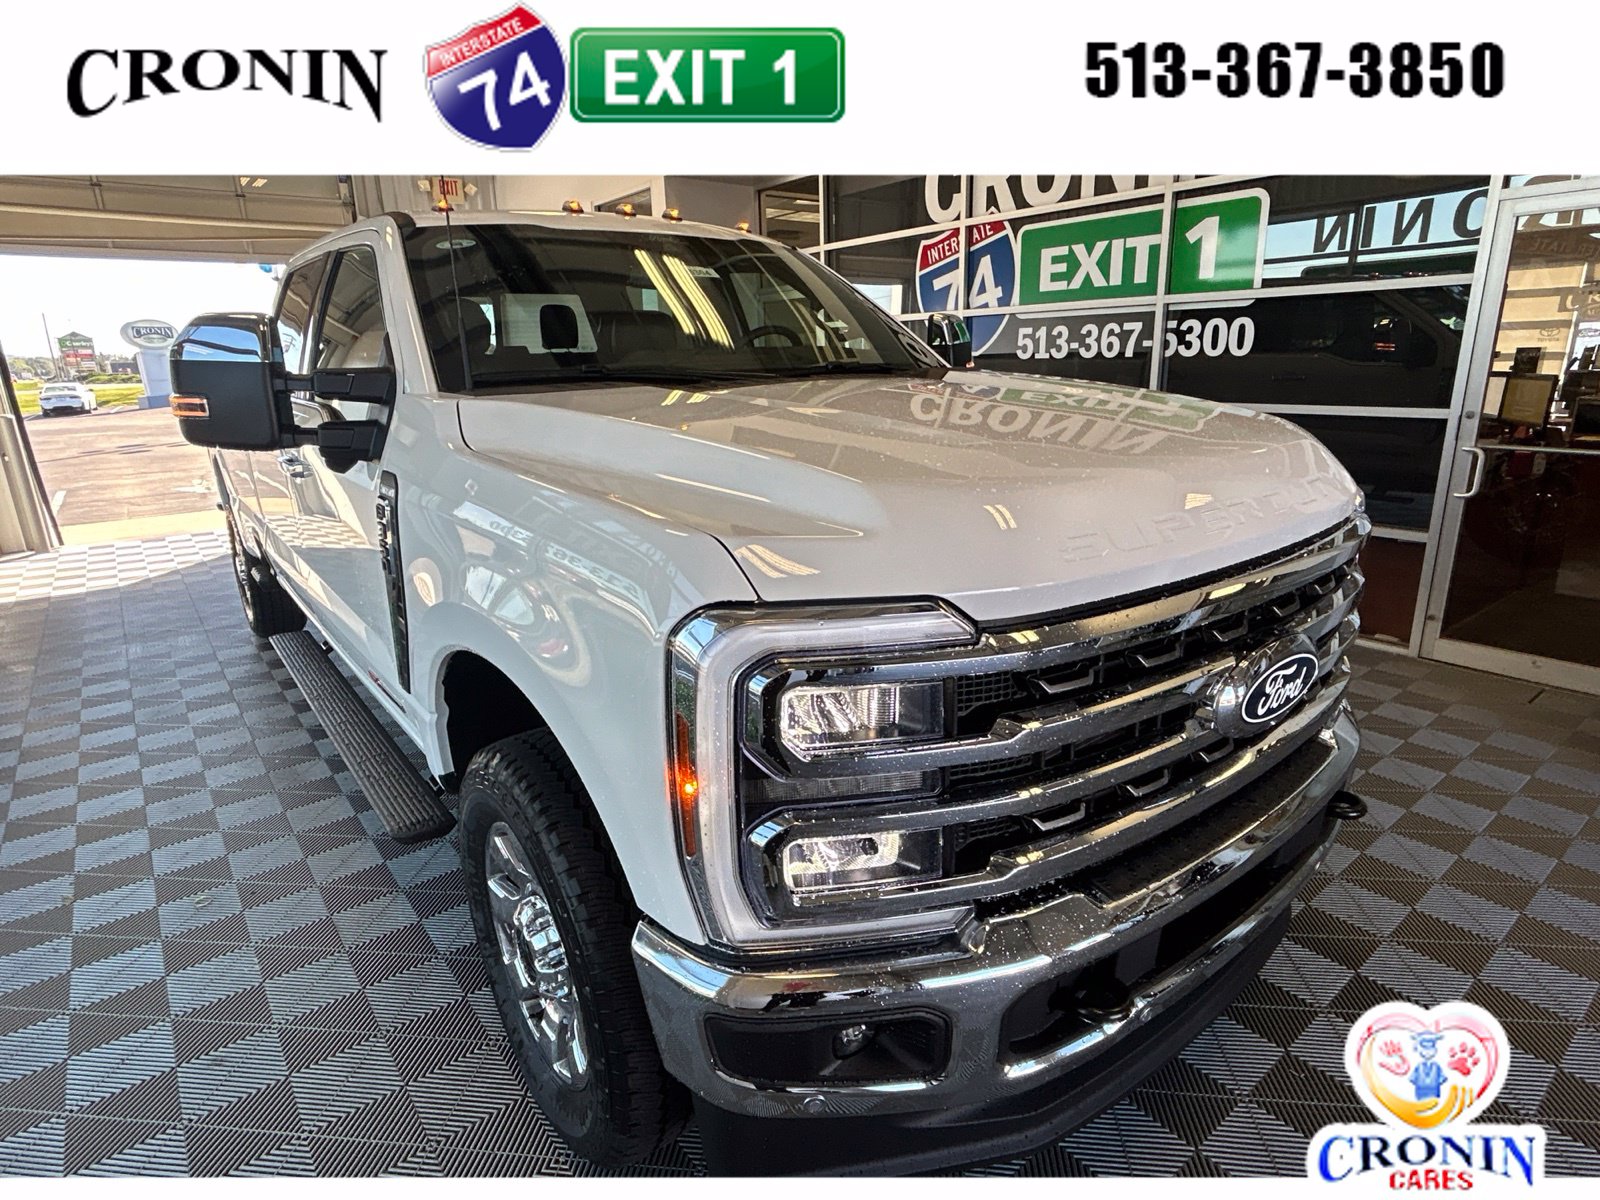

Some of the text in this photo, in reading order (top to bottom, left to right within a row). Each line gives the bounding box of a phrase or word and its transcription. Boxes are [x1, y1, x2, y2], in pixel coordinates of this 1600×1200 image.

[1039, 215, 1221, 293] EXIT 1
[932, 253, 1004, 310] 74
[132, 326, 174, 338] CRONIN
[1015, 316, 1255, 360] 513-367-5300
[1256, 663, 1308, 717] Ford
